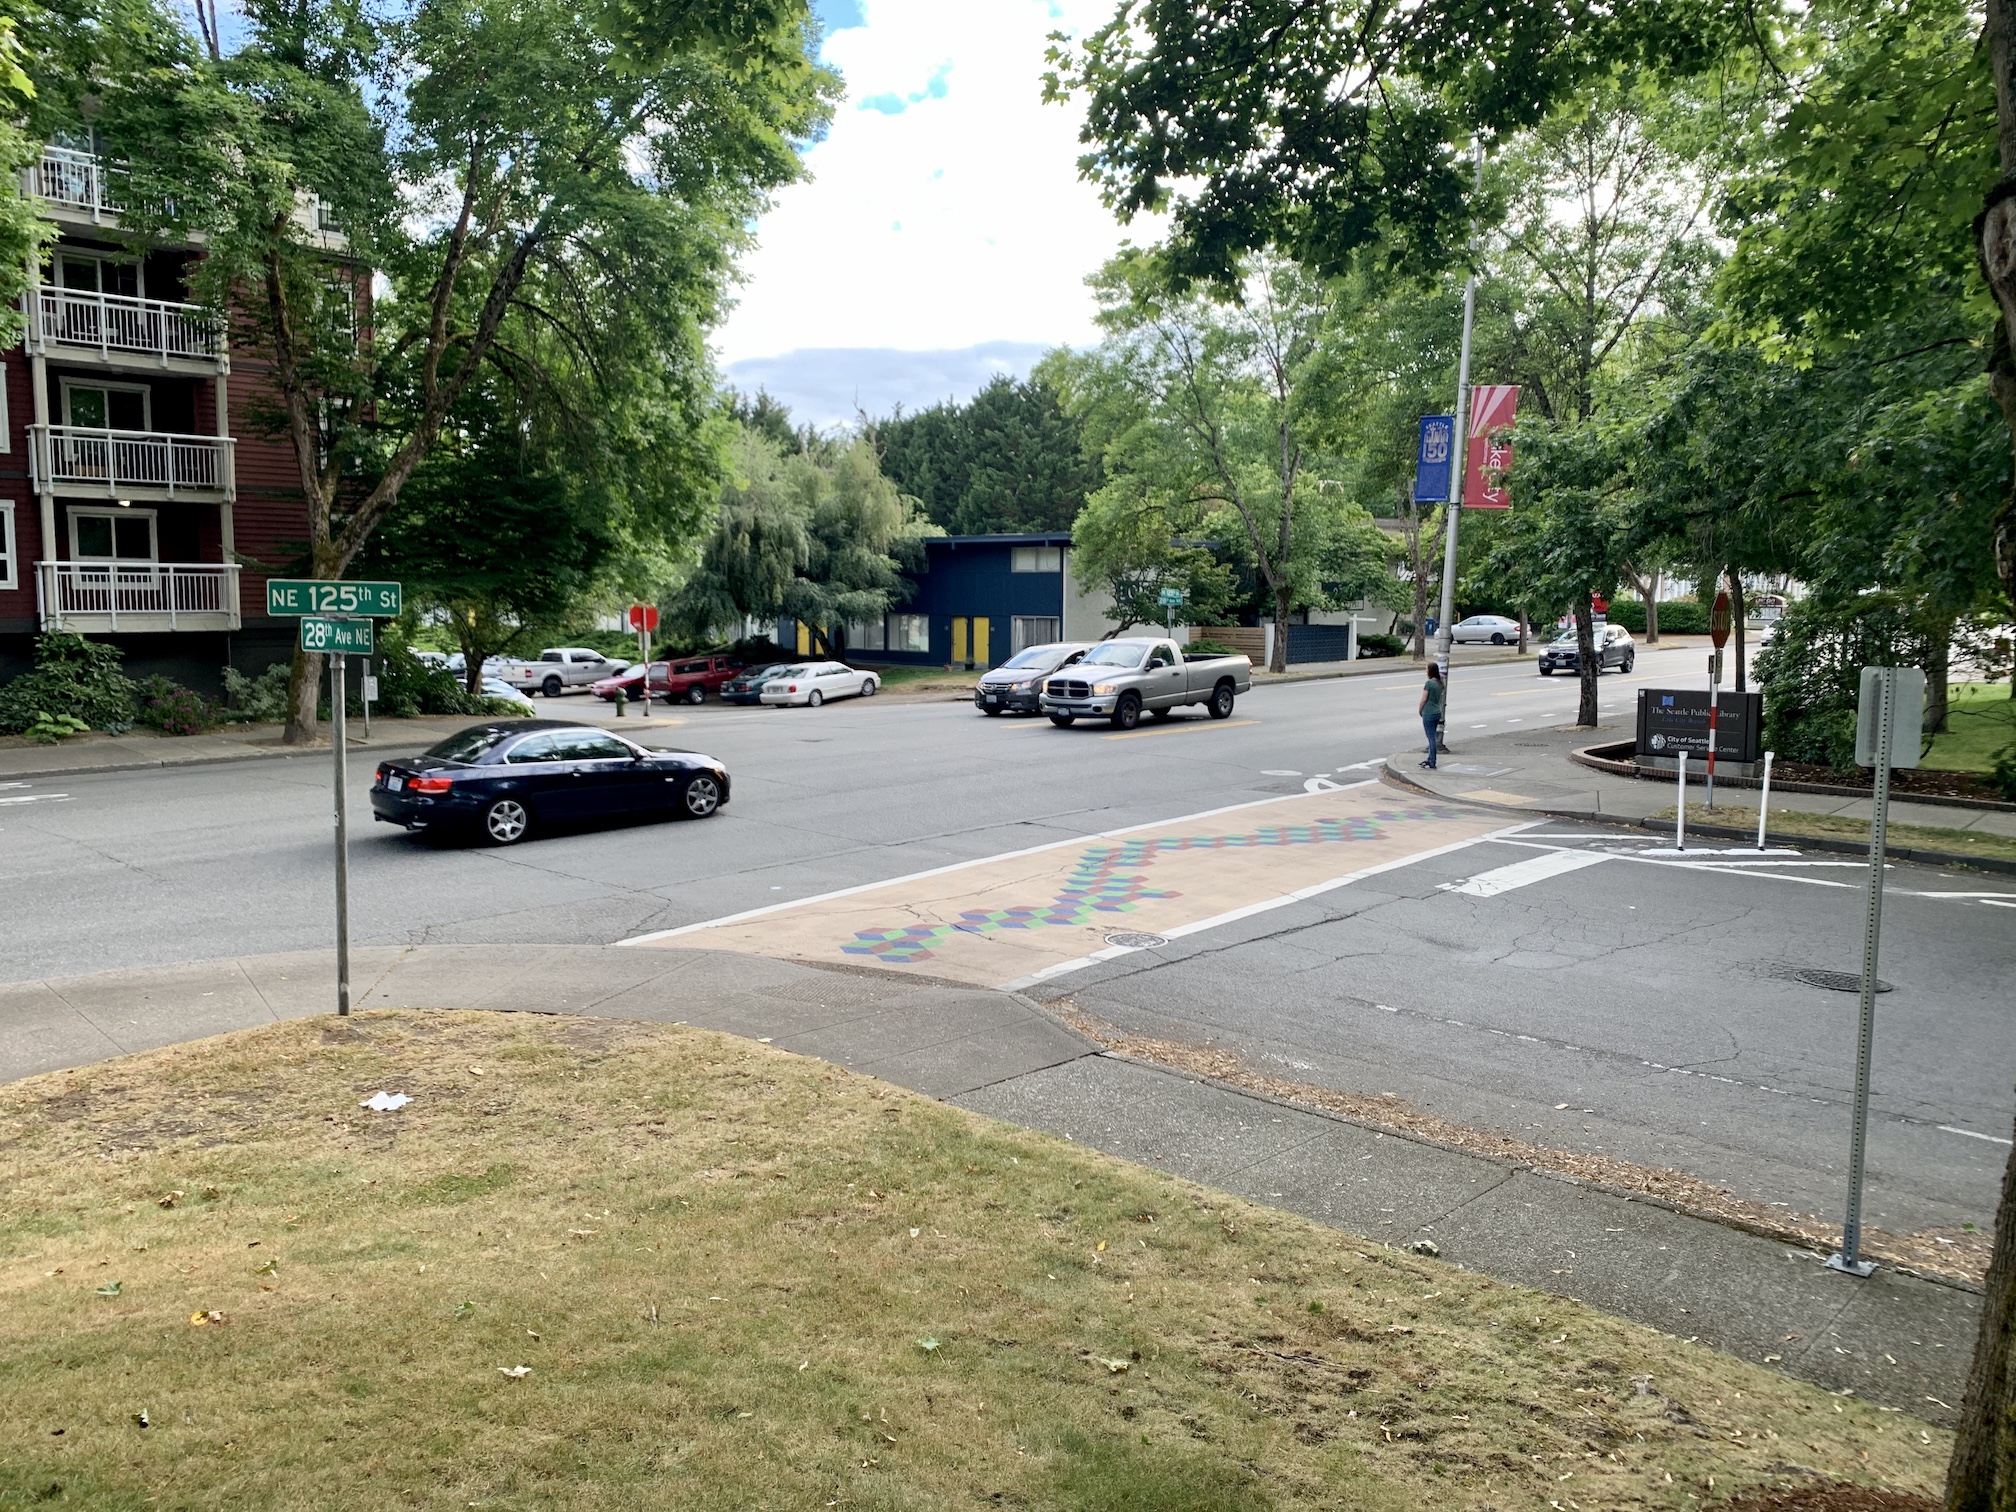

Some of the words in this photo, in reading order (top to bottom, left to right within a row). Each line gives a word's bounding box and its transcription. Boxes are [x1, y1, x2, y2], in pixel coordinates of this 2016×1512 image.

[1425, 421, 1449, 430] SEATTLE
[1423, 442, 1448, 458] 150
[1483, 472, 1502, 503] ty
[272, 589, 298, 607] NE
[309, 586, 372, 611] 125th
[380, 591, 397, 608] St
[305, 622, 333, 647] 28th
[335, 628, 352, 645] Ave
[355, 628, 370, 646] NE
[1651, 706, 1664, 714] The
[1666, 707, 1690, 716] Seattle
[1688, 736, 1710, 744] Seattle
[1667, 743, 1695, 751] Customer
[1719, 746, 1739, 754] Center
